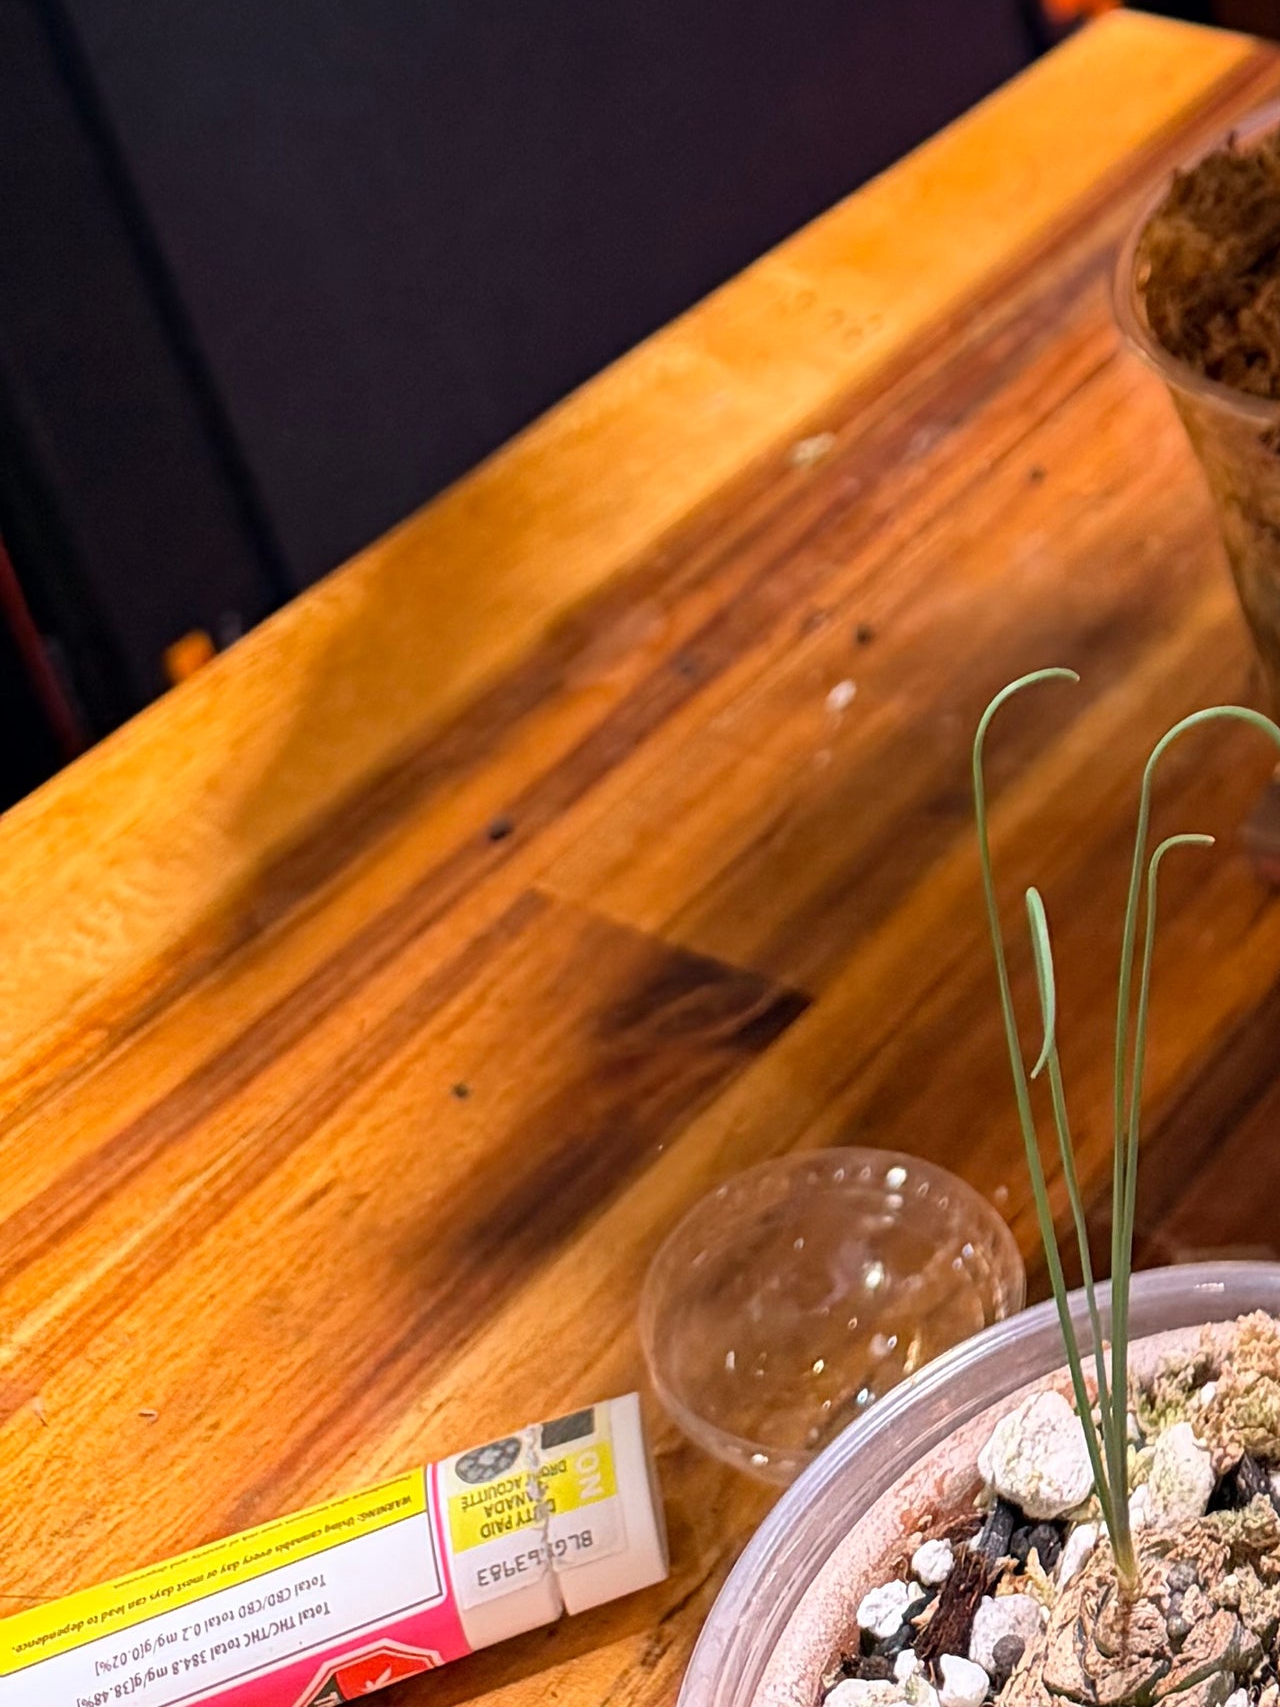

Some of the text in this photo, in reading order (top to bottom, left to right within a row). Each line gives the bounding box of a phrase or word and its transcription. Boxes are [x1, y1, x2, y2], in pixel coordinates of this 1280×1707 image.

[525, 1460, 567, 1485] DROT
[484, 1480, 548, 1518] NADA
[325, 1517, 355, 1533] Using
[480, 1516, 513, 1538] PAID
[275, 1529, 322, 1552] cannabis
[221, 1561, 240, 1573] day
[243, 1548, 272, 1565] every
[177, 1575, 204, 1591] most
[207, 1570, 217, 1579] or
[295, 1574, 326, 1596] Total
[128, 1597, 146, 1609] can
[150, 1586, 174, 1600] days
[239, 1588, 291, 1618] CBD/CBD
[87, 1616, 98, 1624] to
[101, 1605, 125, 1623] lead
[204, 1611, 234, 1632] total
[298, 1602, 330, 1625] Total
[12, 1621, 84, 1653] dependence.
[182, 1623, 201, 1641] 0.2
[243, 1616, 296, 1647] THC/THC
[210, 1637, 240, 1660] total
[172, 1650, 207, 1675] 384.8
